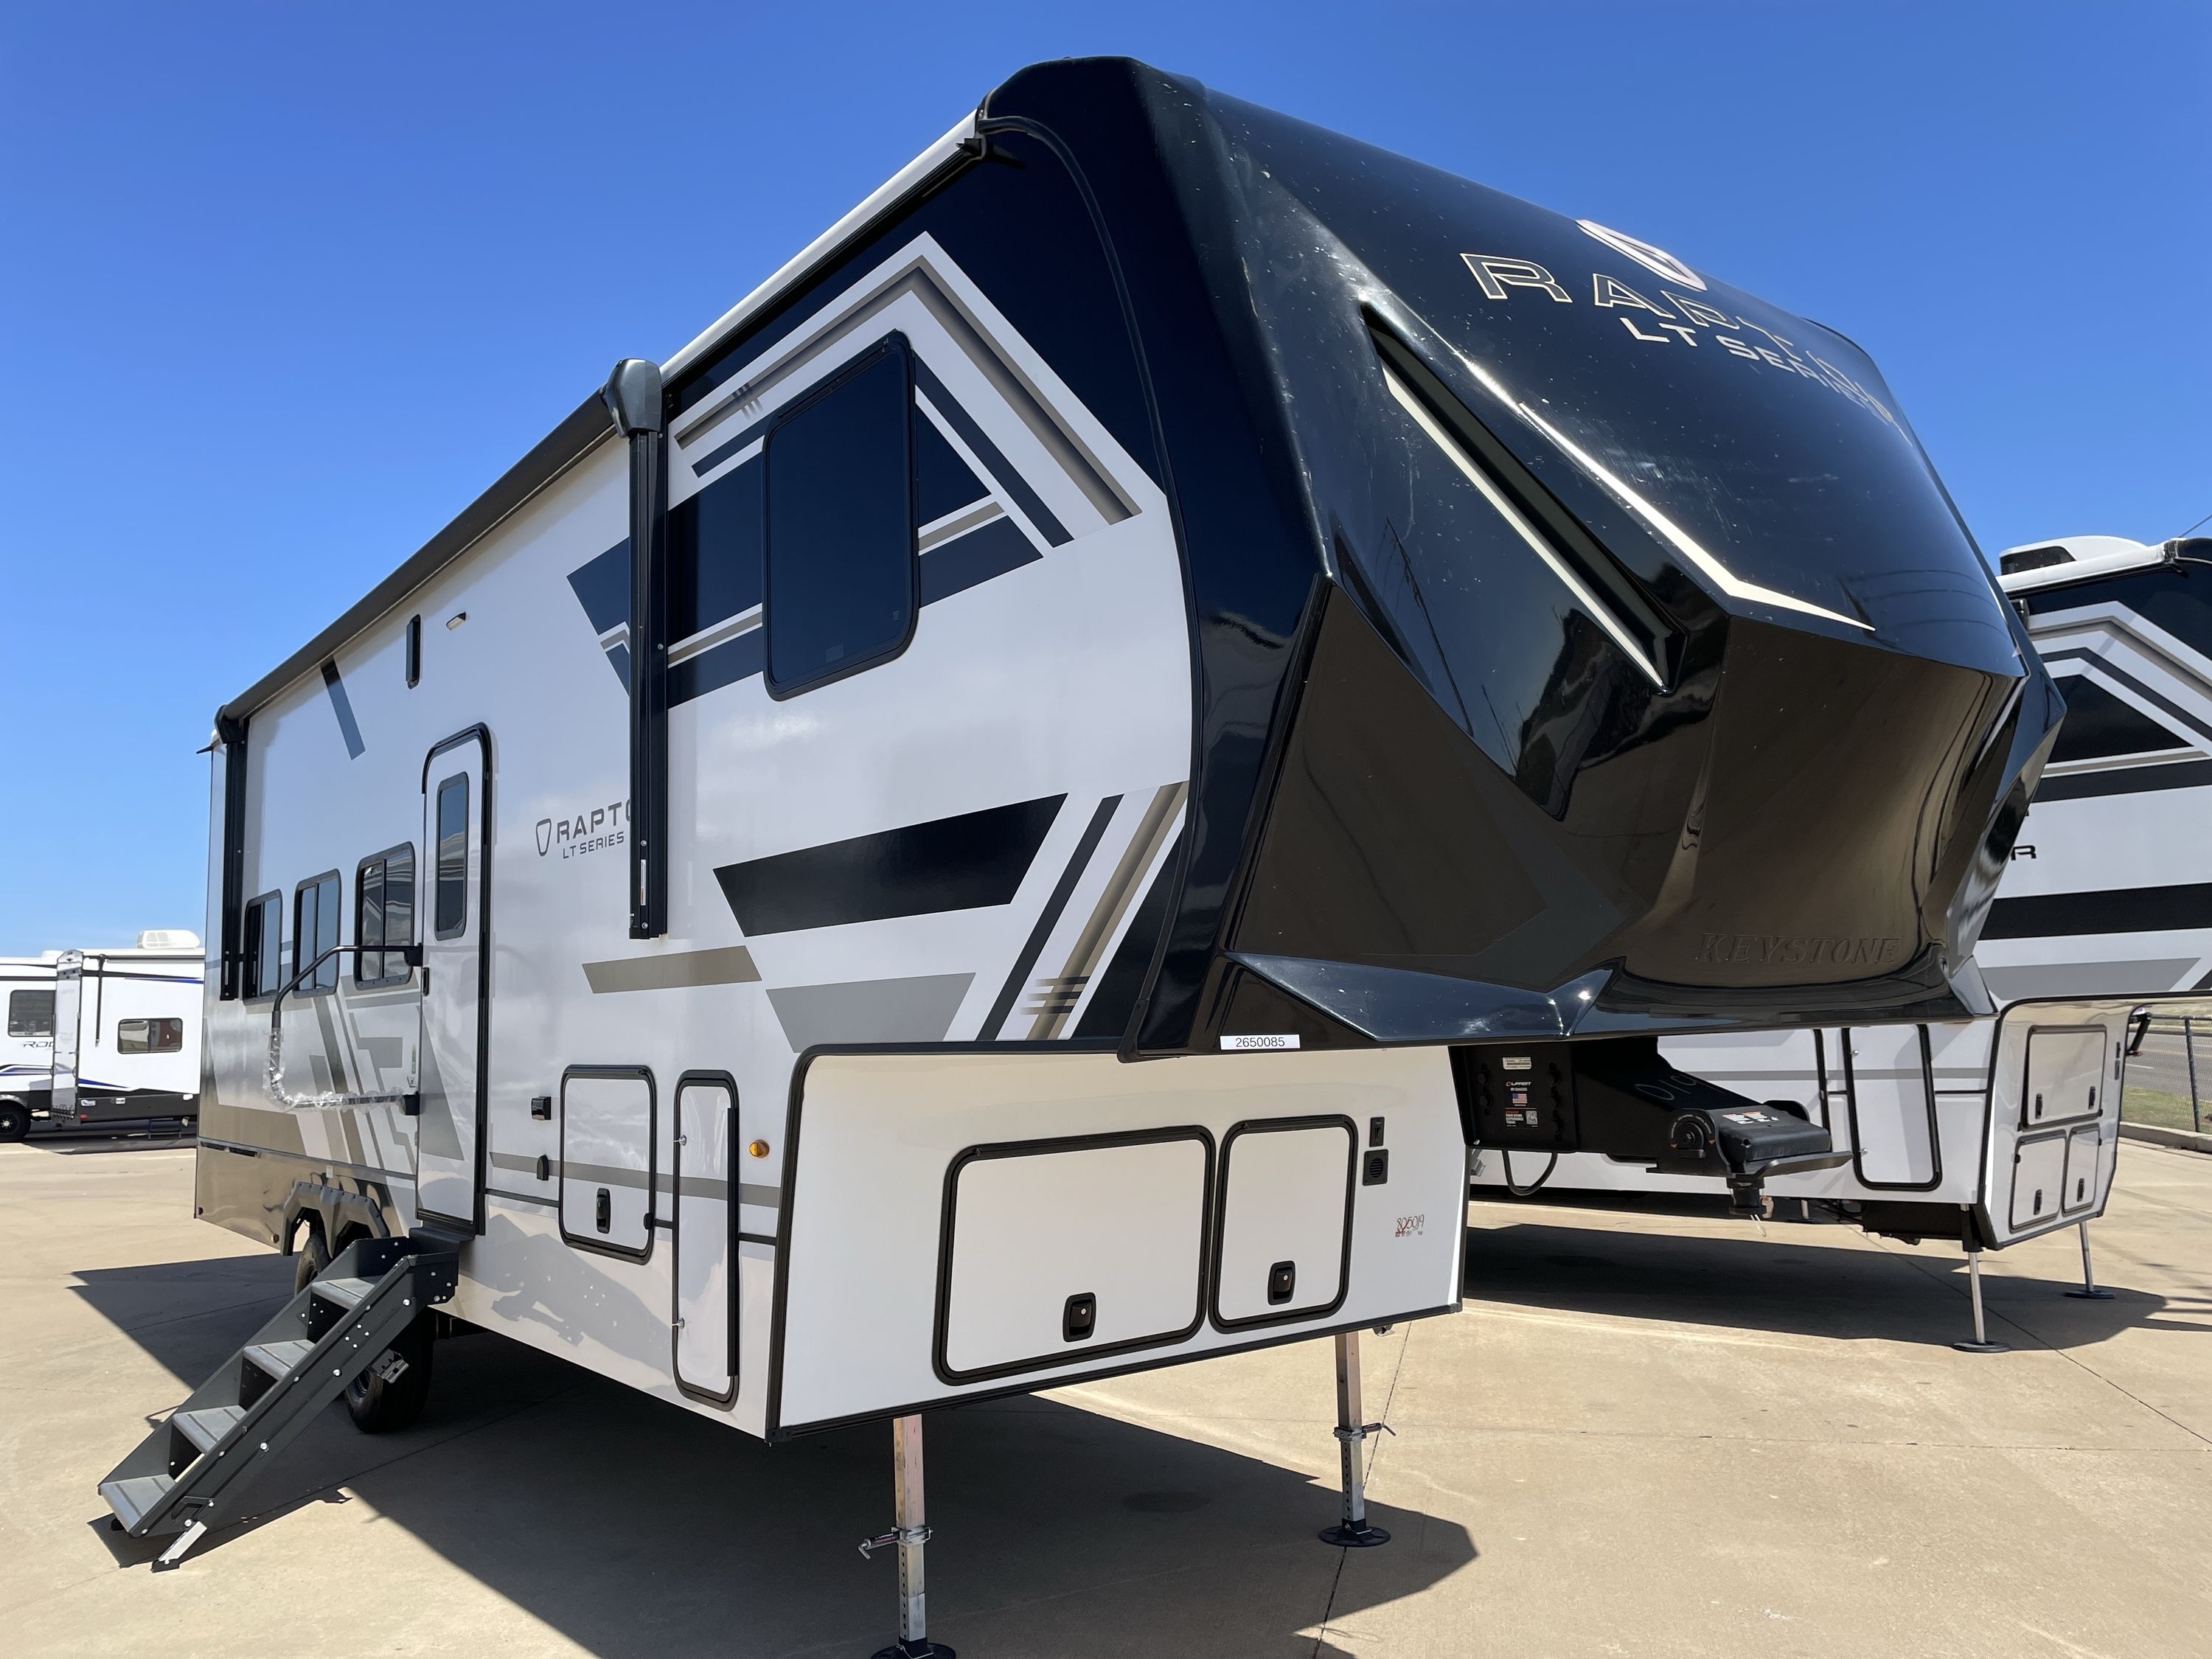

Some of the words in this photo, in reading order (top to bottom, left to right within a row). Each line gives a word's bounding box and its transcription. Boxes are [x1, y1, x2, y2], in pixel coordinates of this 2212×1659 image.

[1620, 317, 1697, 347] LT
[1715, 335, 1890, 426] SERIES
[563, 845, 577, 859] LT
[580, 831, 625, 855] SERIES
[1694, 933, 1901, 964] KEYSTONE
[1235, 1037, 1285, 1048] 2650085
